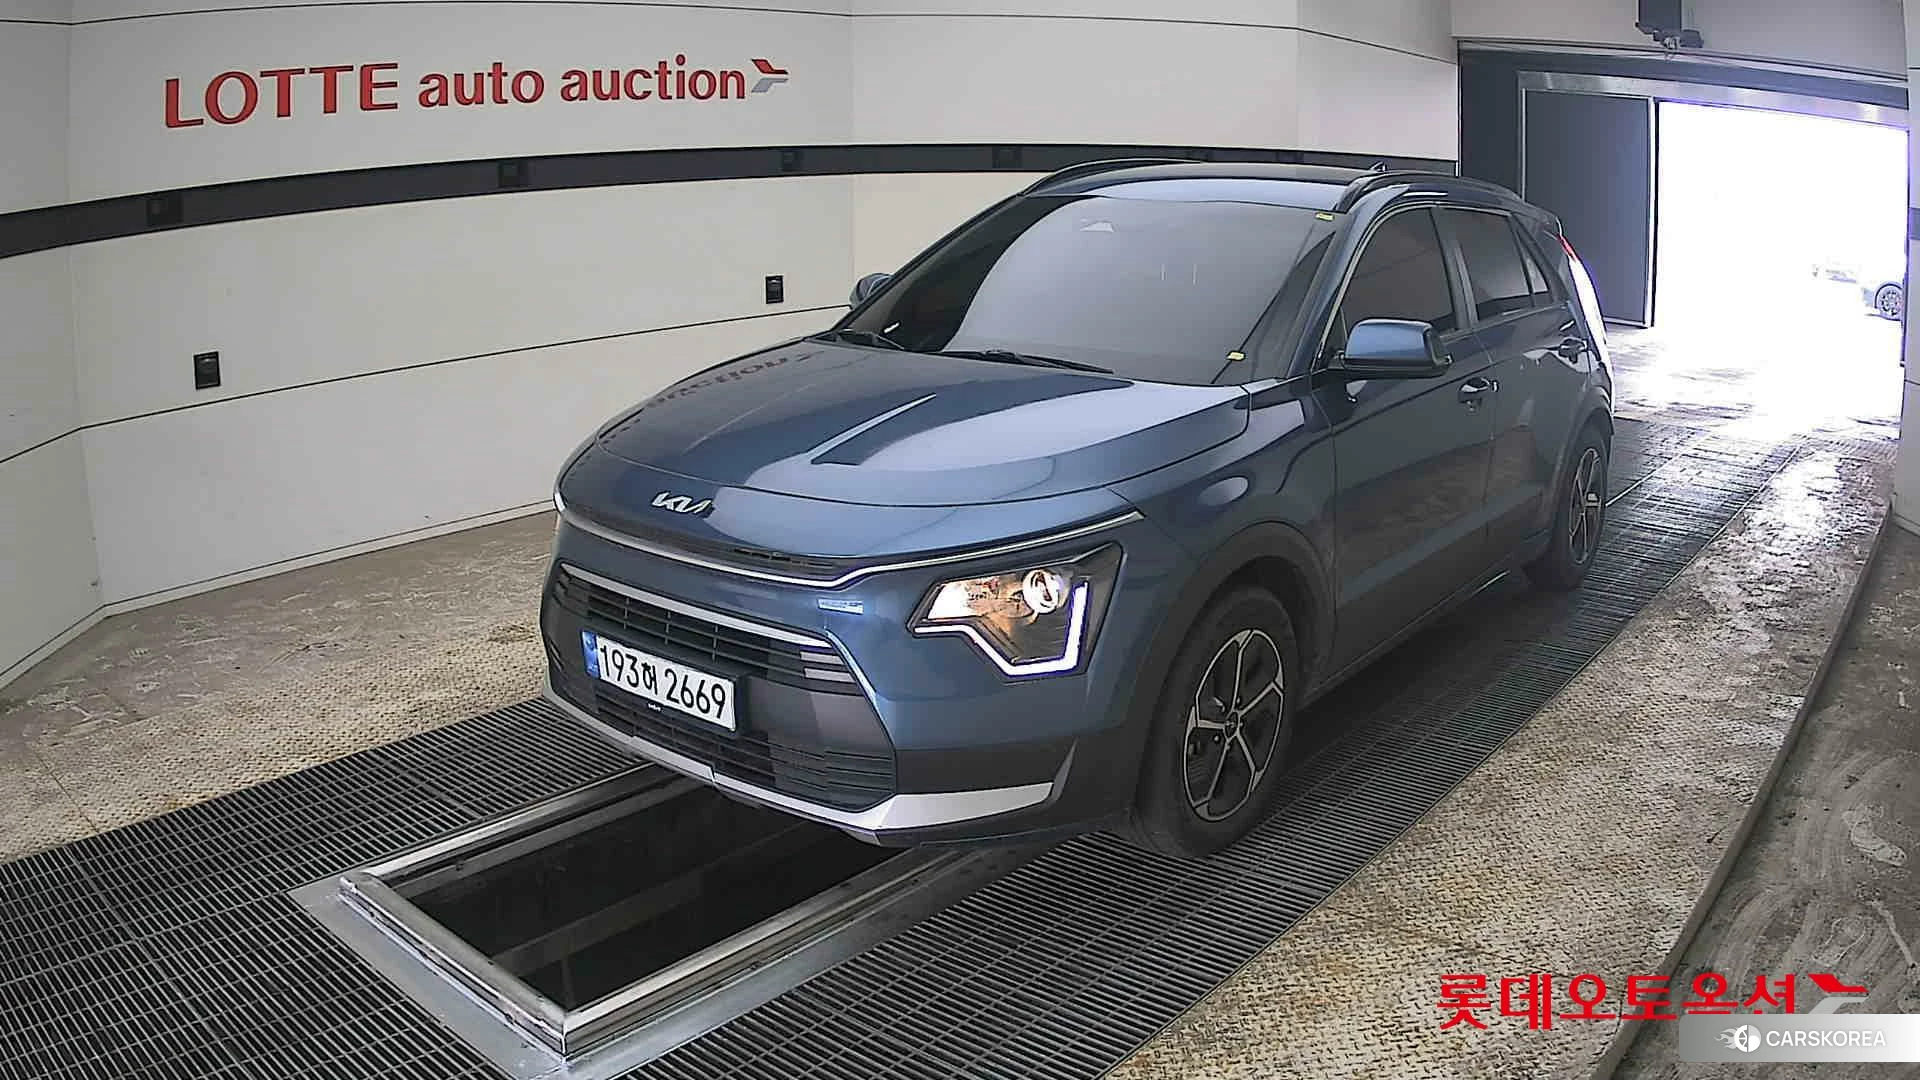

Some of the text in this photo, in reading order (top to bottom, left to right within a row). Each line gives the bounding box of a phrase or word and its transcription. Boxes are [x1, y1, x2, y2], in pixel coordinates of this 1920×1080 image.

[165, 54, 746, 129] LOTTE auto auction
[600, 645, 727, 720] 193허 2669
